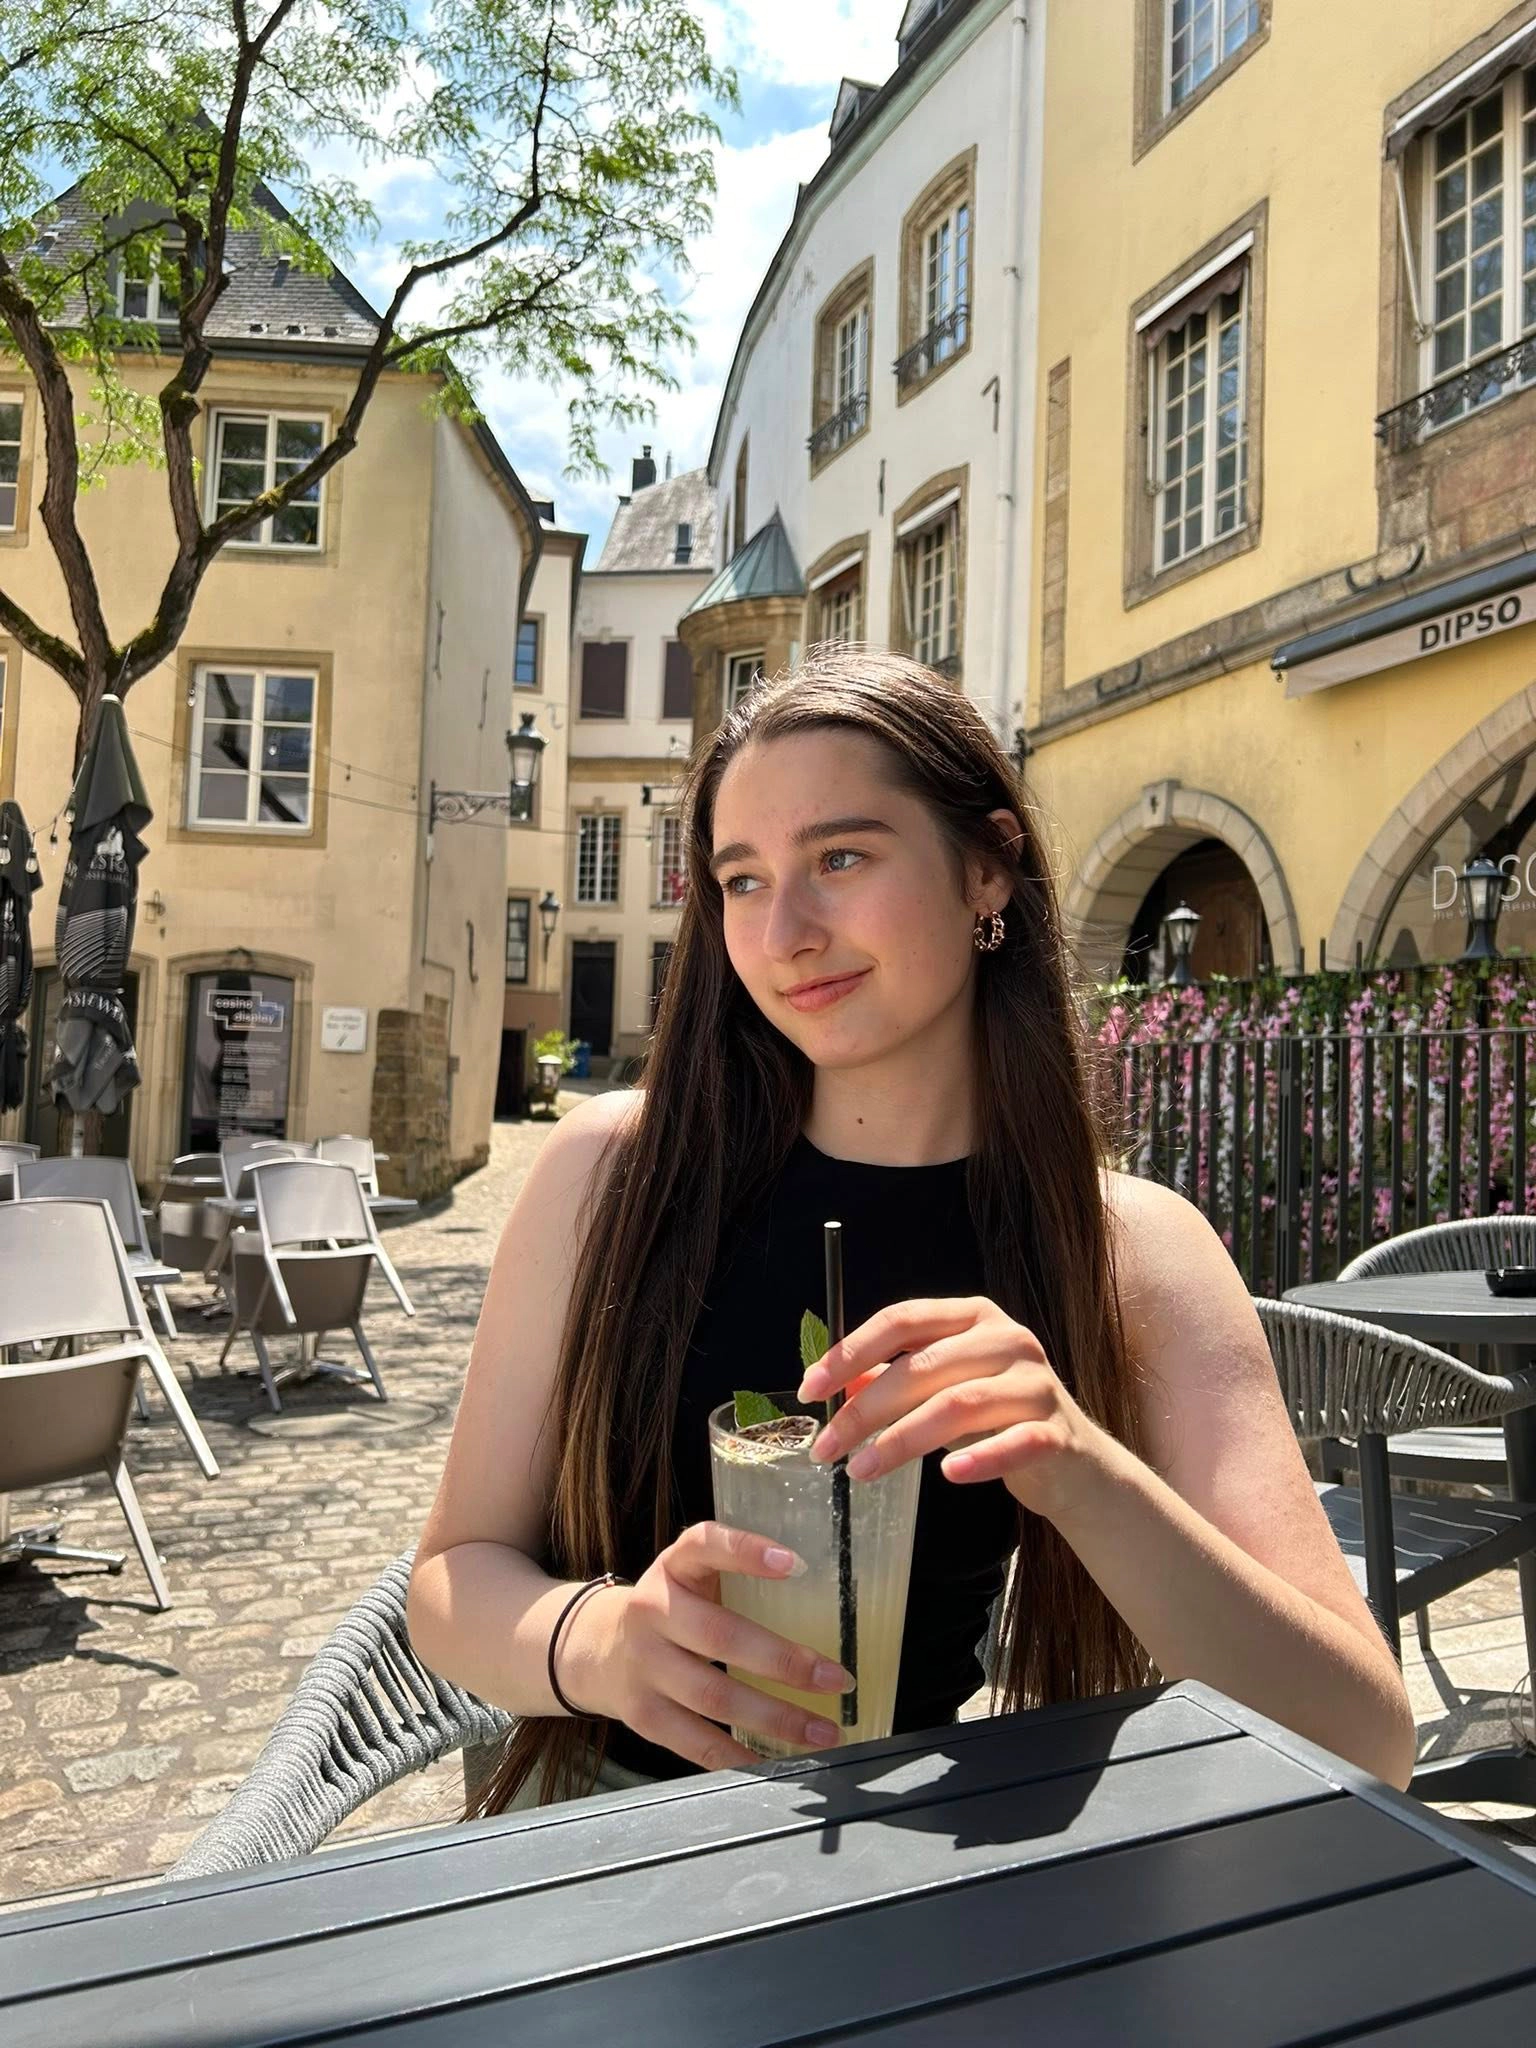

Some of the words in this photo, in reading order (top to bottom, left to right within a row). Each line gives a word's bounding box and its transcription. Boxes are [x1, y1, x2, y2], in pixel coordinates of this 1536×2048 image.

[1420, 596, 1521, 651] DIPSO
[215, 997, 253, 1010] casino
[233, 1011, 275, 1025] display
